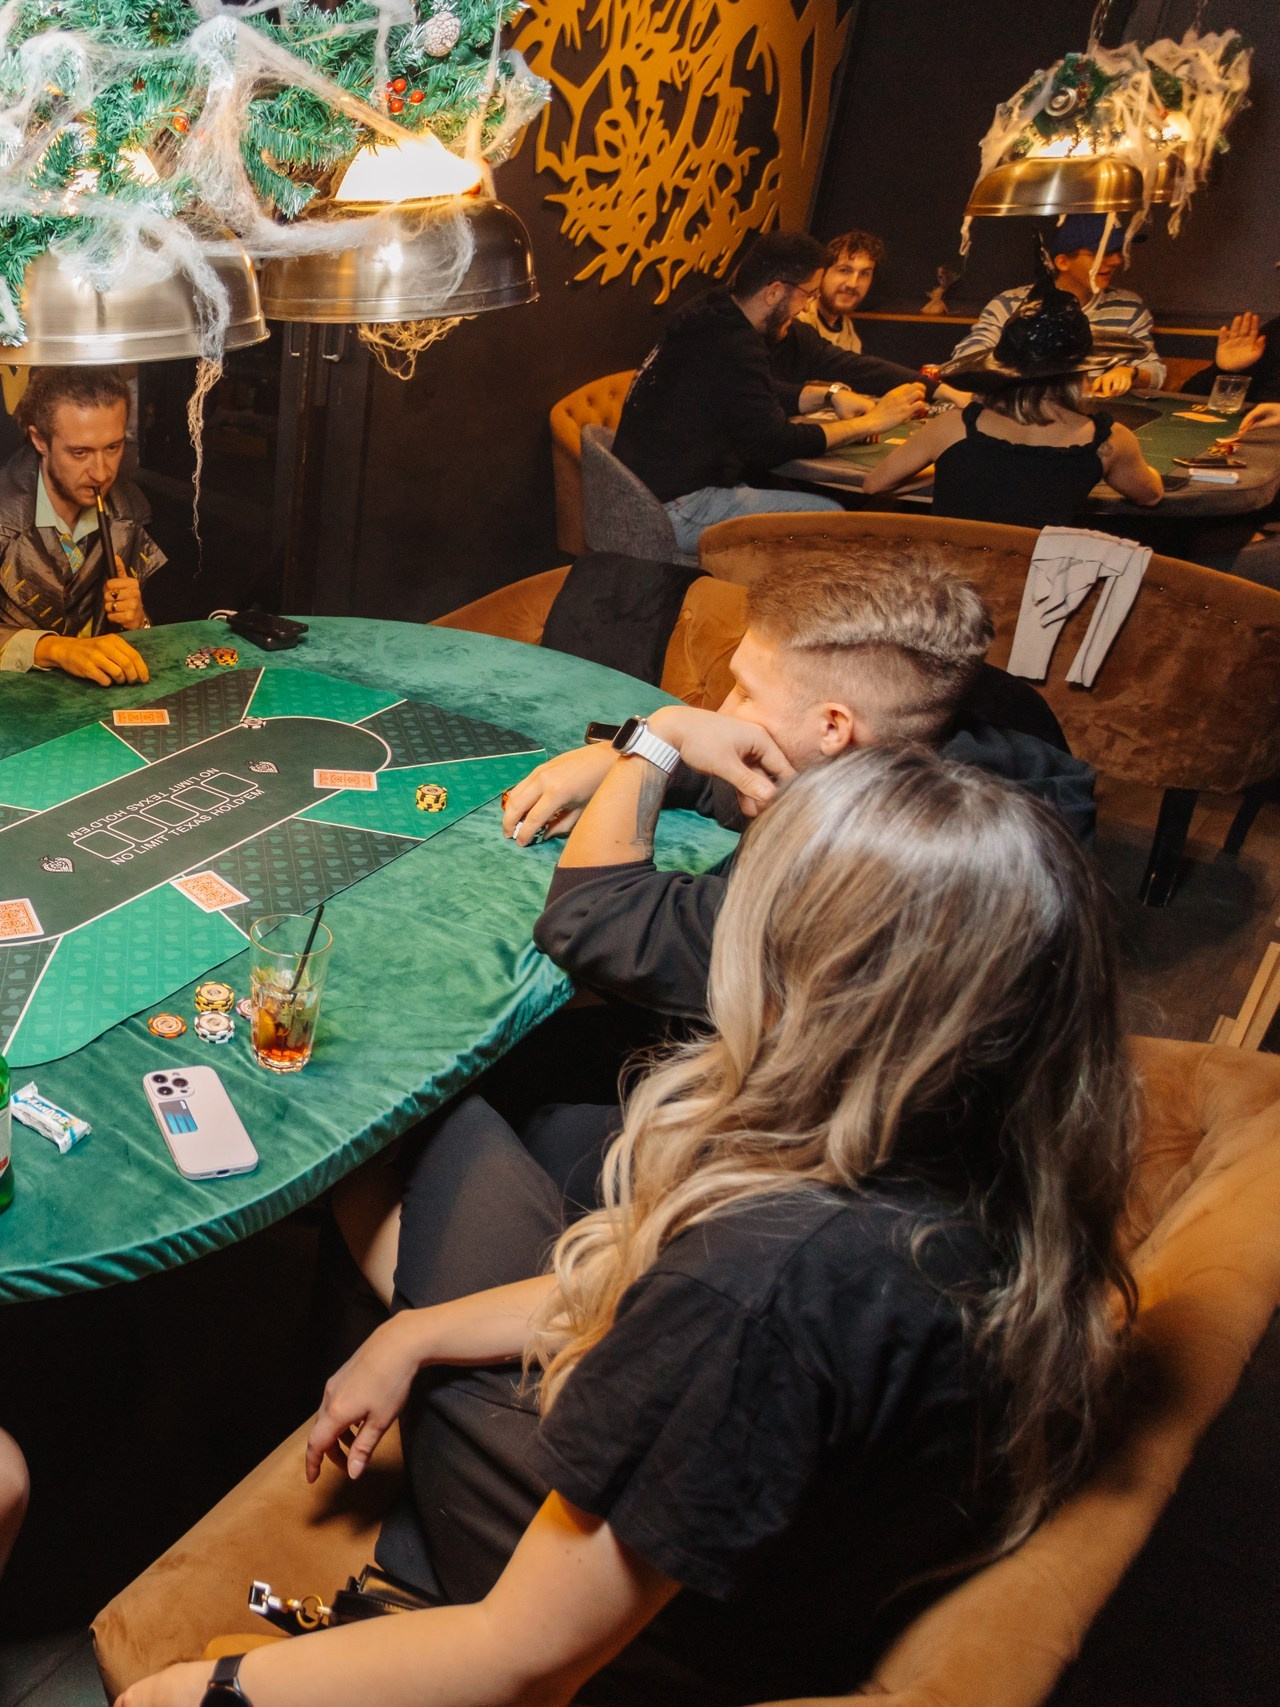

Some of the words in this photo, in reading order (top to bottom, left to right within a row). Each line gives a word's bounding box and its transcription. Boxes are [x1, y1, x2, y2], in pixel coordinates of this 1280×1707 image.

[199, 767, 220, 778] NO
[168, 774, 200, 793] LIMIT
[126, 791, 169, 812] TEXAS
[67, 810, 128, 839] HOLD'EM
[111, 852, 134, 866] NO
[134, 834, 170, 855] LIMIT
[168, 814, 212, 837] TEXAS
[211, 788, 266, 817] HOLD'EM
